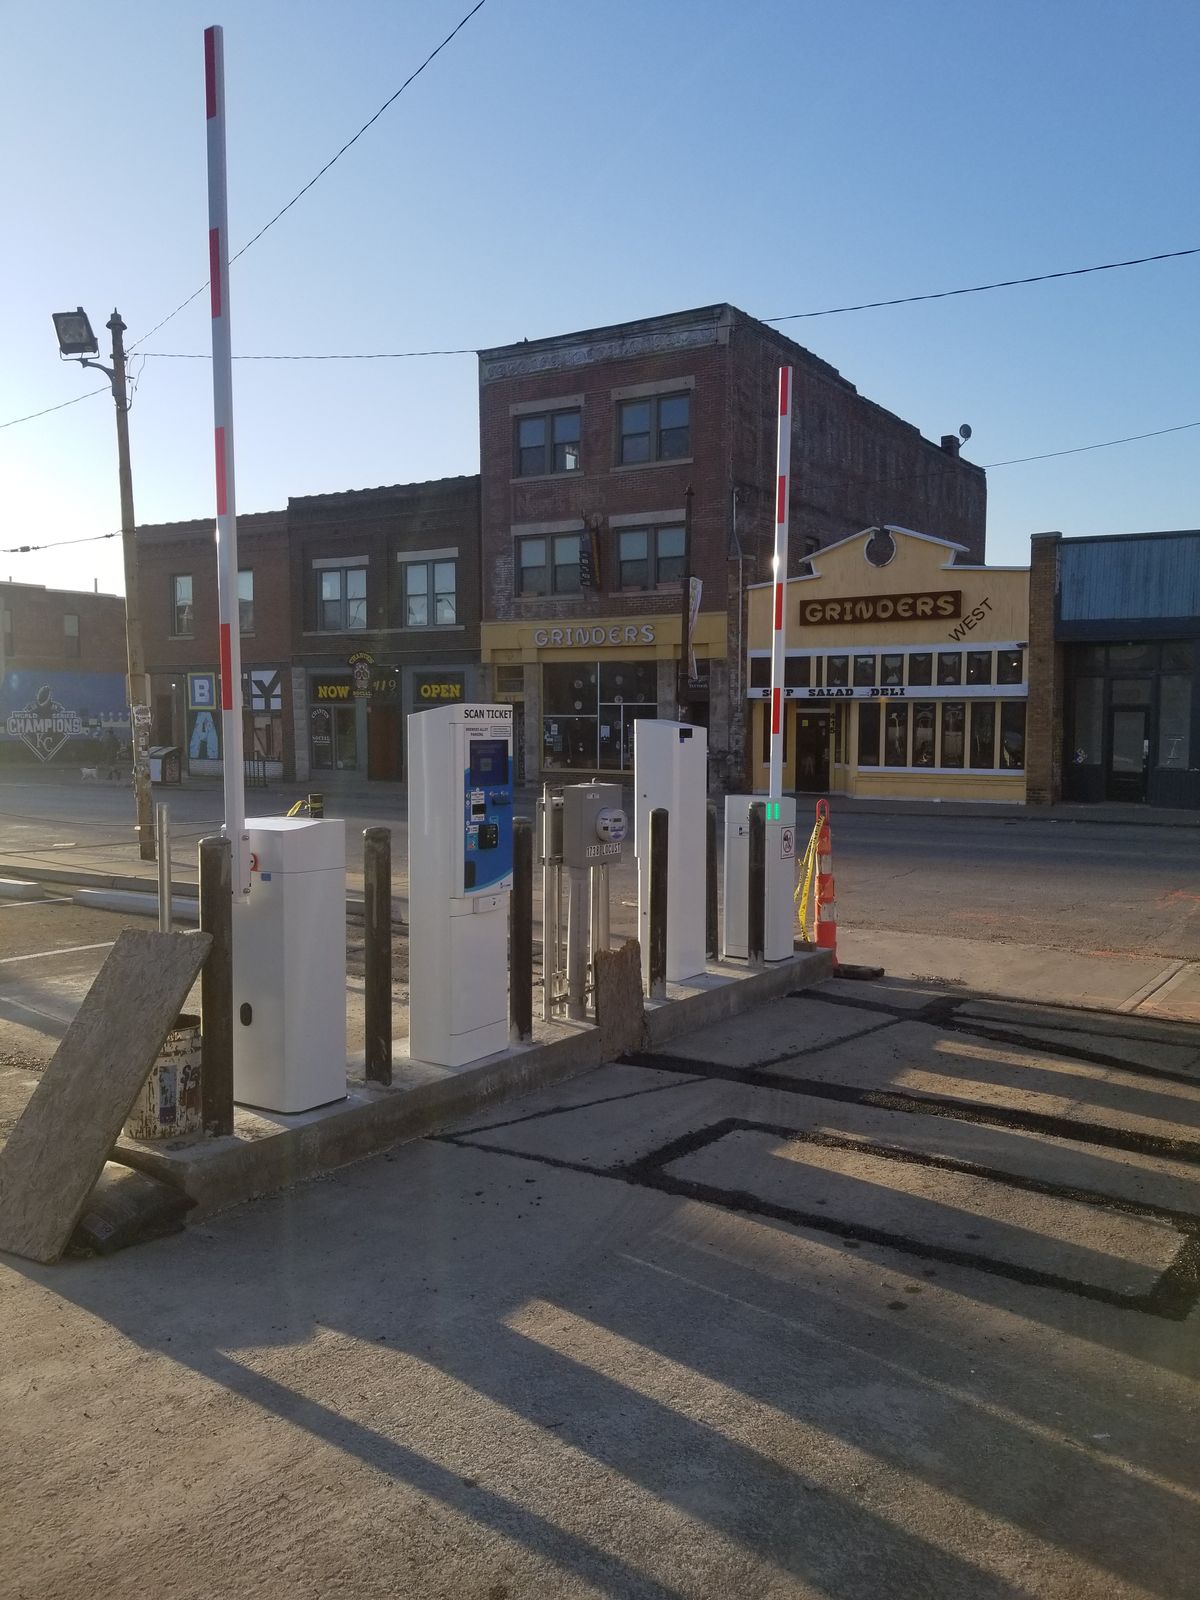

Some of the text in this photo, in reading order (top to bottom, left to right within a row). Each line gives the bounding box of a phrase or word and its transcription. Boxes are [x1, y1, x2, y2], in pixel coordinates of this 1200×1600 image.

[804, 594, 956, 623] GRINDERS
[947, 596, 993, 643] WEST
[534, 623, 656, 647] GRINDERS
[317, 685, 351, 699] NOW
[419, 683, 462, 699] OPEN
[808, 688, 854, 698] SALAD
[870, 687, 905, 697] DELI
[464, 709, 513, 719] SCAN TICKET
[8, 718, 81, 733] CHAMPIONS
[35, 732, 53, 752] KC
[602, 842, 621, 856] LOCUST
